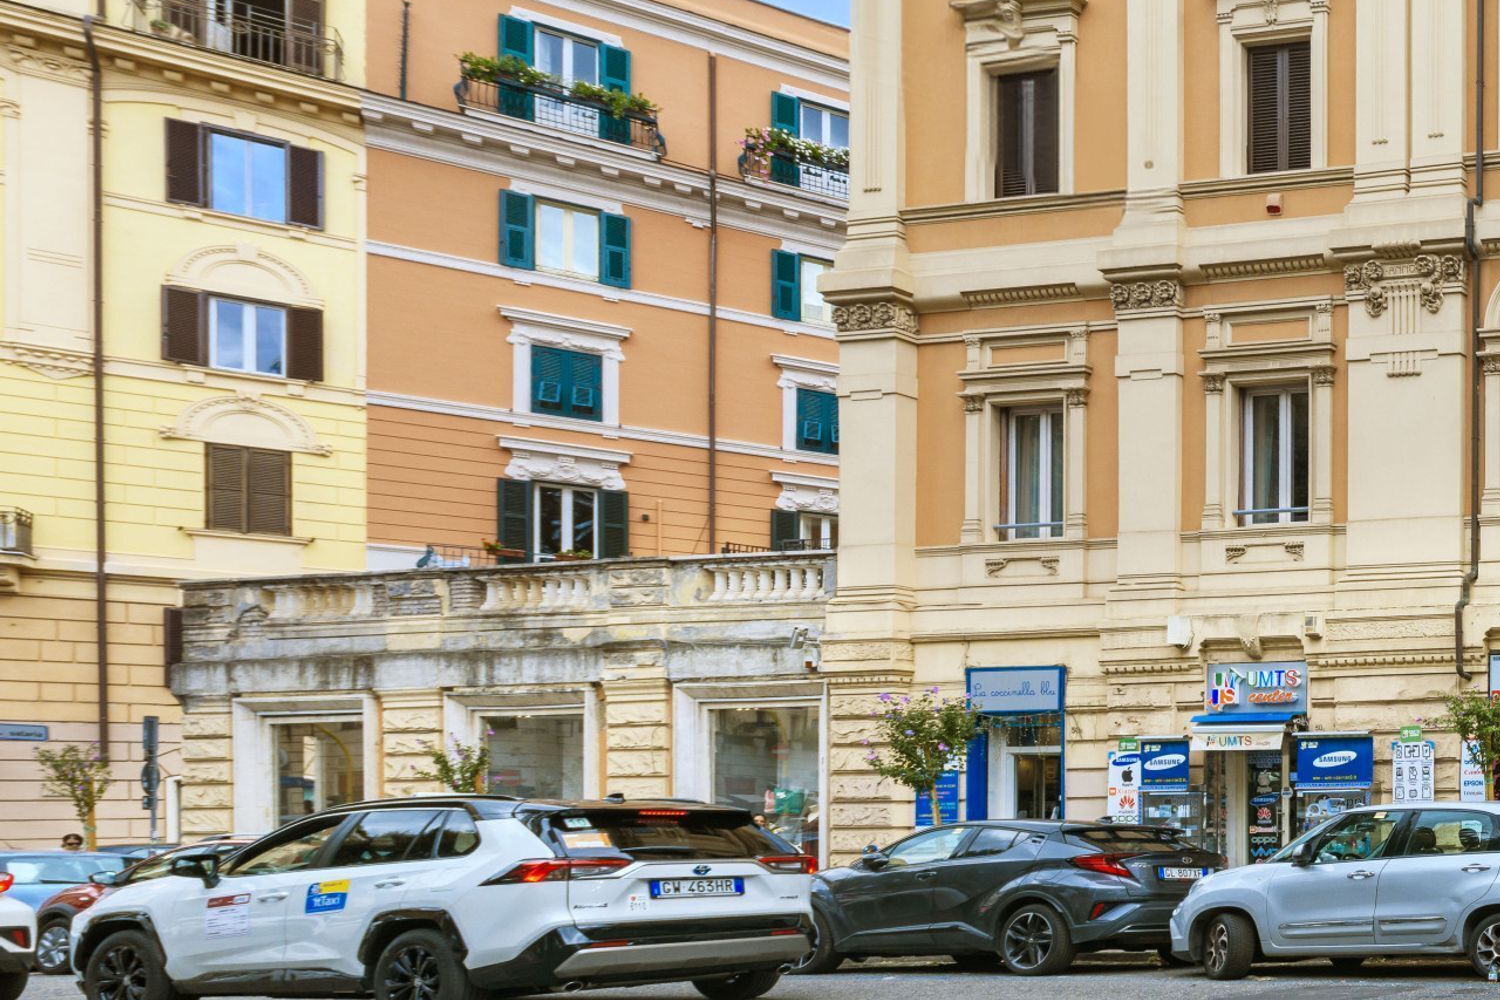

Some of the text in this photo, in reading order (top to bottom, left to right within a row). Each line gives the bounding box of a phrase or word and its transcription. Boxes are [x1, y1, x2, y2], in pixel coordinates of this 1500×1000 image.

[1246, 669, 1301, 688] UMTS
[973, 682, 986, 697] La
[1040, 680, 1056, 696] blu
[1219, 736, 1252, 747] UMTS
[1149, 758, 1182, 766] SAMSUNG
[1319, 755, 1353, 763] SAMSUNG
[662, 878, 733, 894] GW 463HR
